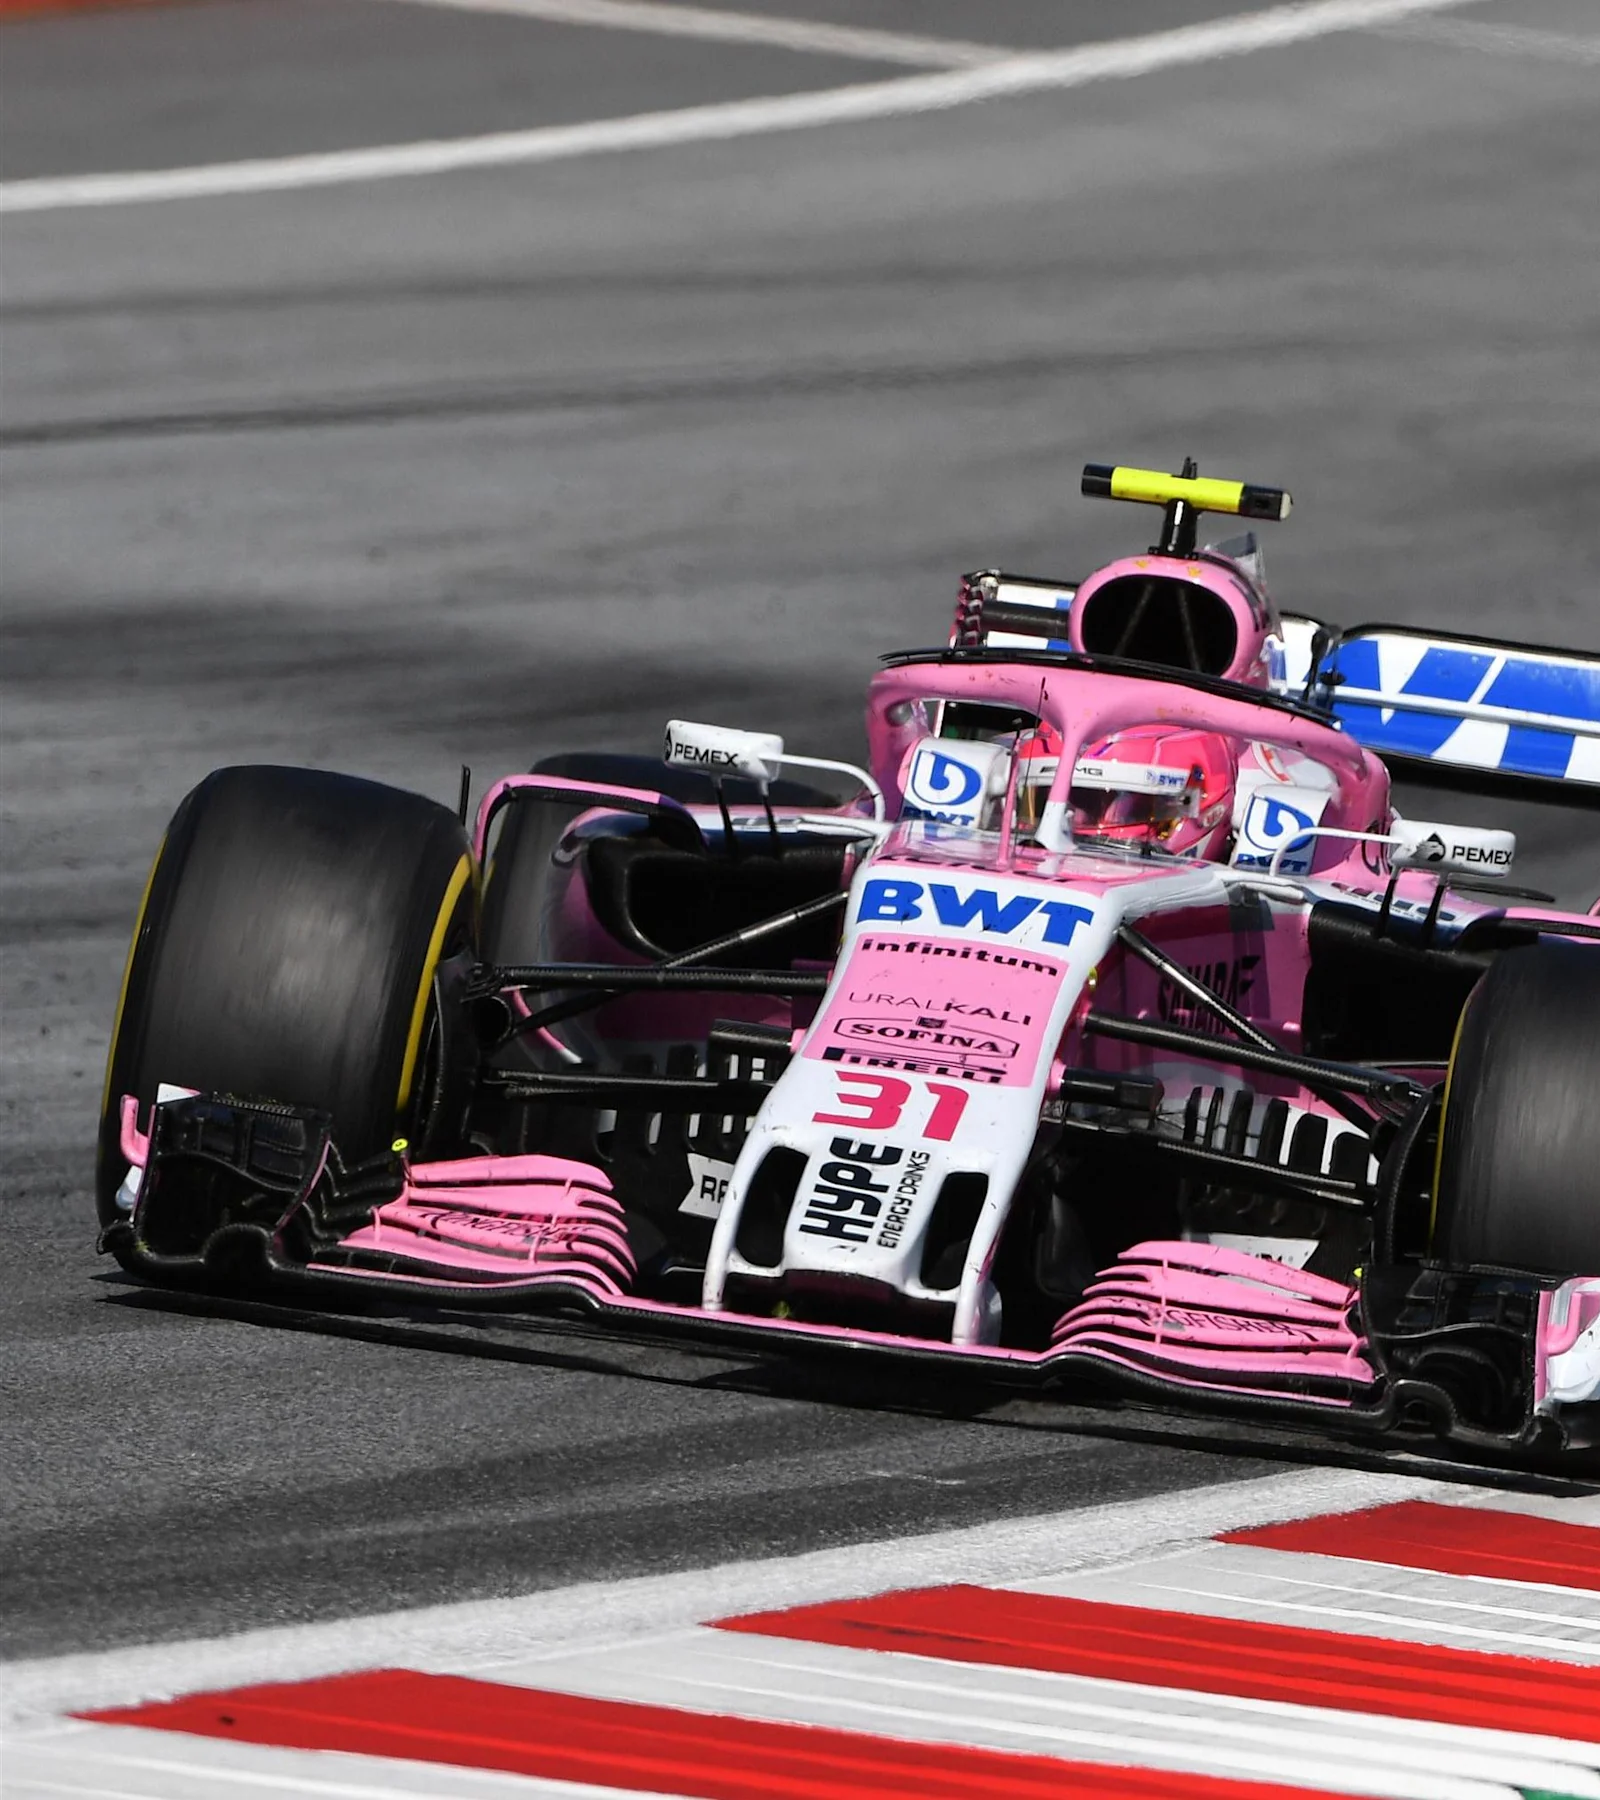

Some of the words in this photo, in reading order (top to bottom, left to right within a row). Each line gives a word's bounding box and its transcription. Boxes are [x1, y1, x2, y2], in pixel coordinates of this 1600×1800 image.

[674, 742, 739, 768] PEMEX
[1451, 845, 1512, 865] PEMEX
[857, 879, 1094, 947] BWT
[862, 938, 1058, 977] infinitum
[849, 991, 1032, 1026] URALKALI
[850, 1022, 1003, 1054] SOFINA
[822, 1046, 1008, 1084] PIRELLI
[811, 1070, 970, 1142] 31
[798, 1136, 904, 1243] HYPE
[876, 1194, 913, 1249] ENERGY
[896, 1150, 931, 1196] DRINKS
